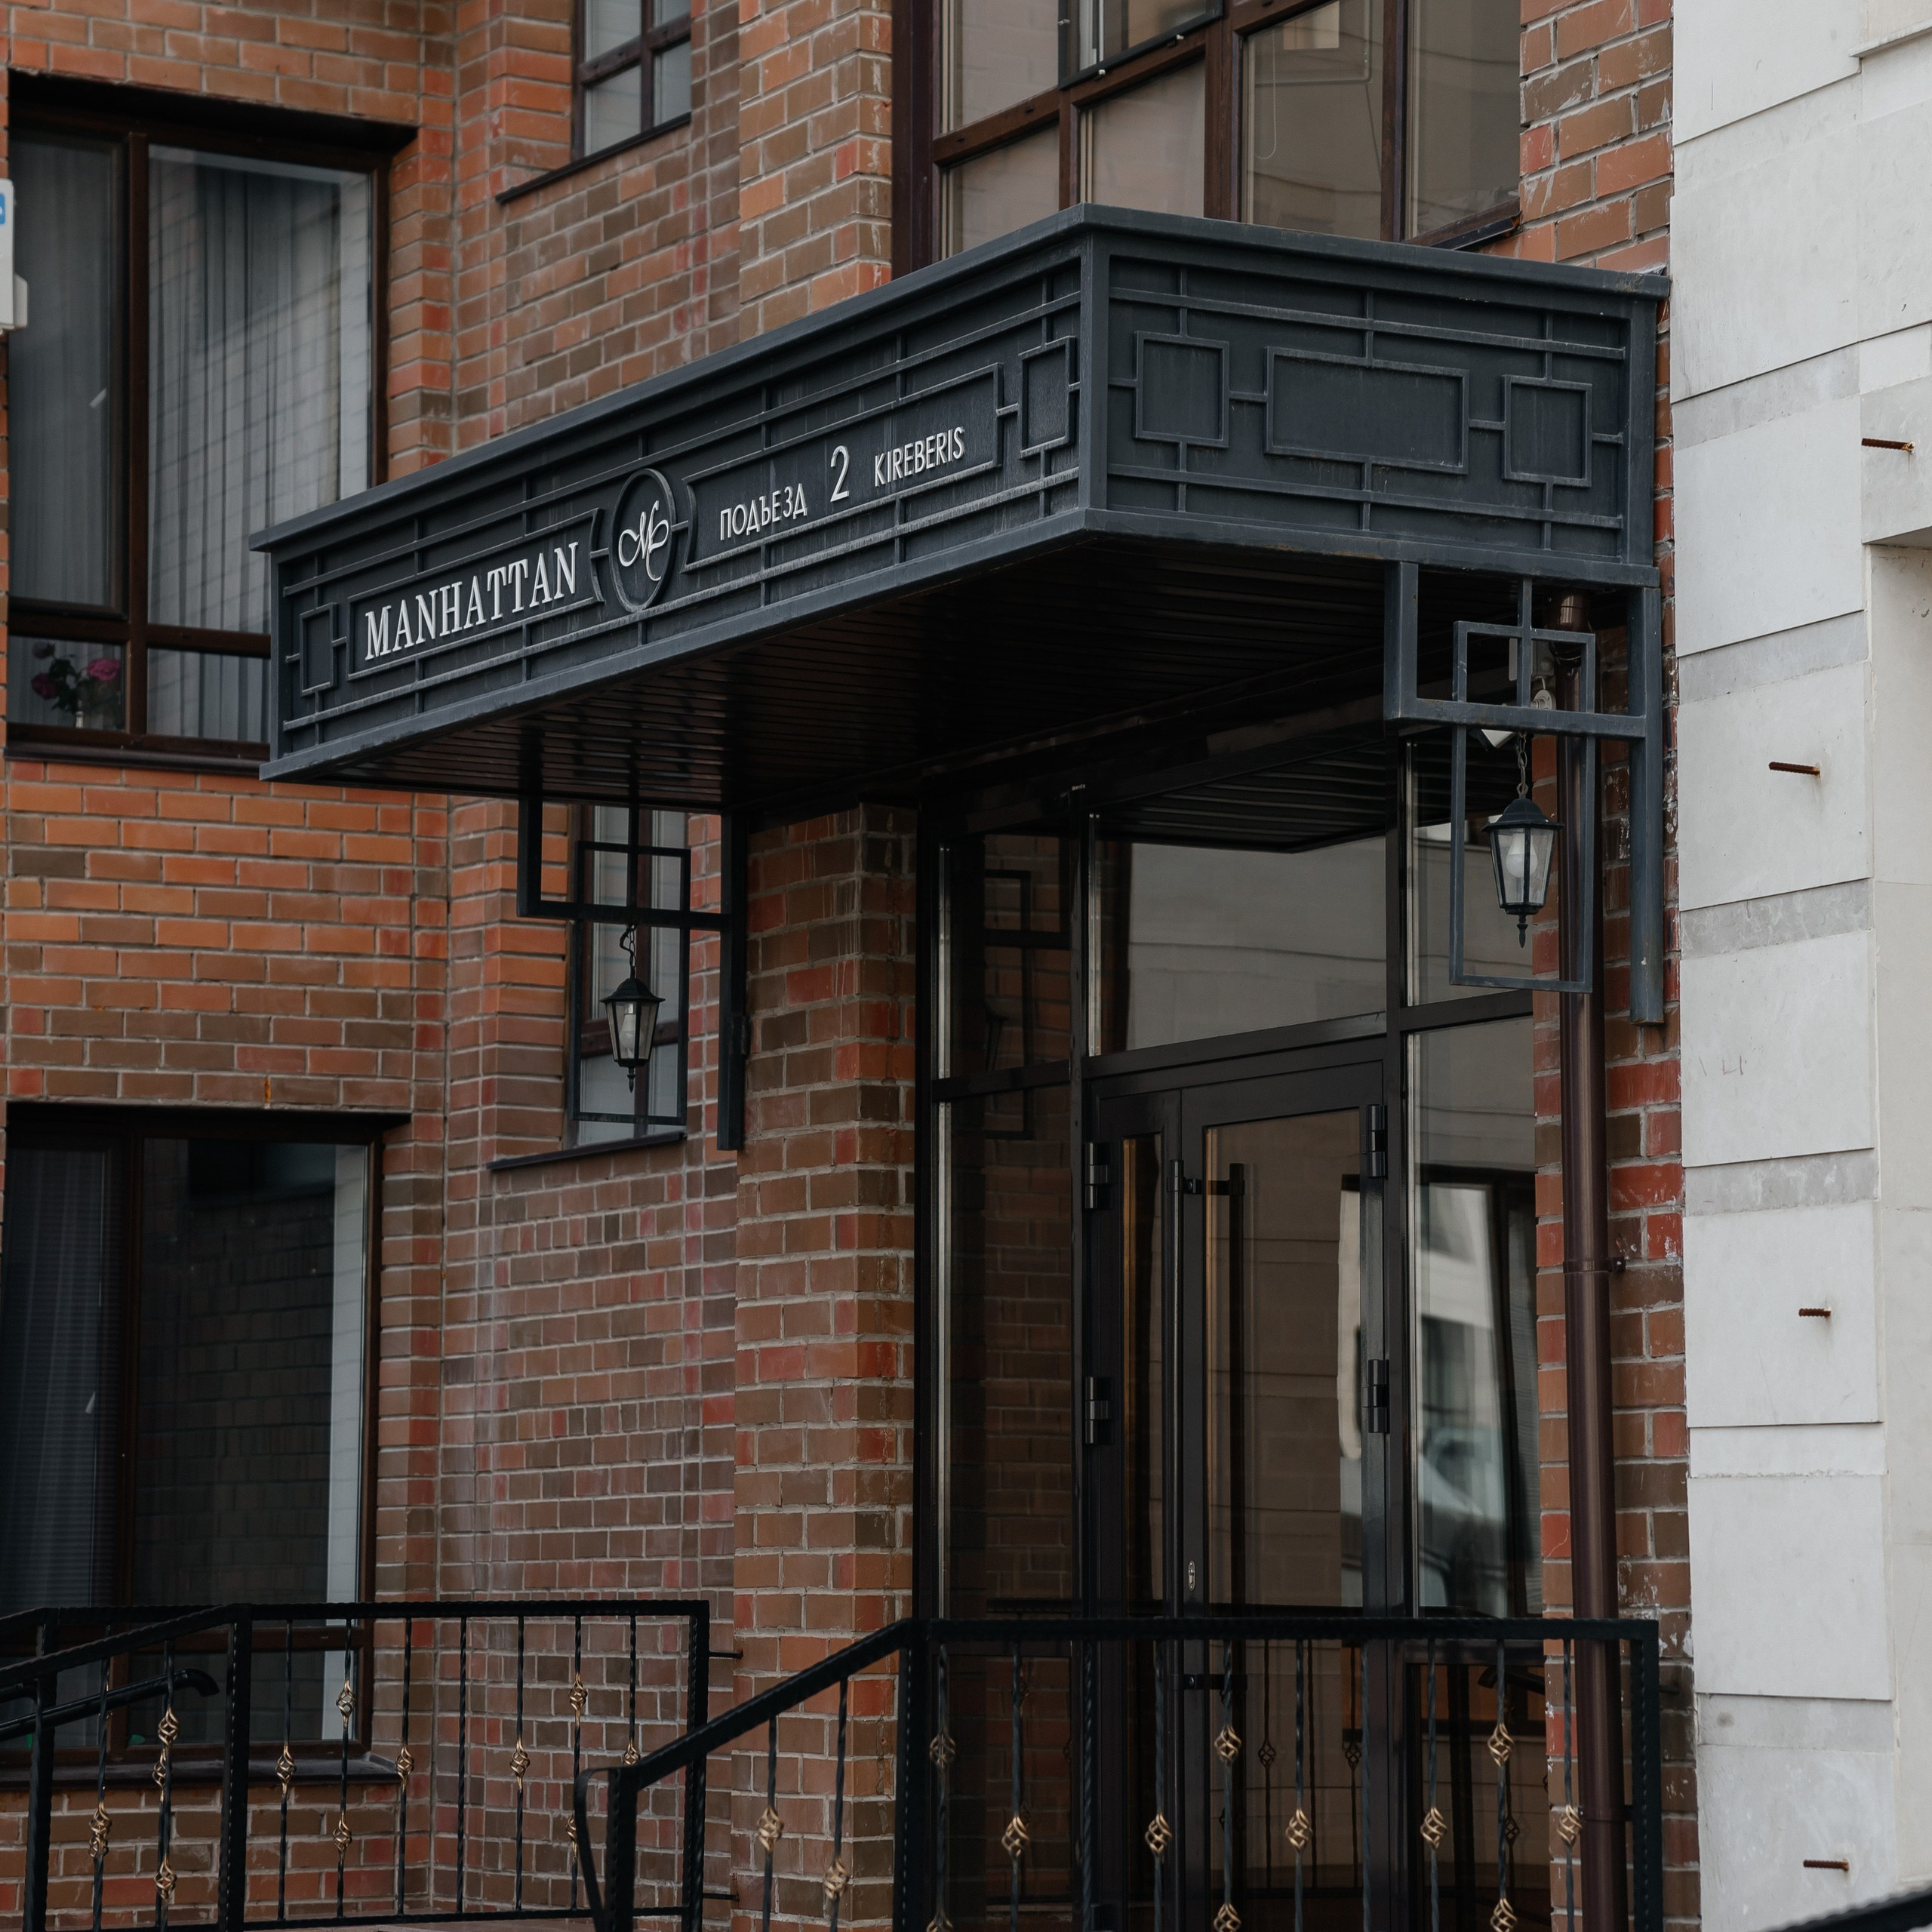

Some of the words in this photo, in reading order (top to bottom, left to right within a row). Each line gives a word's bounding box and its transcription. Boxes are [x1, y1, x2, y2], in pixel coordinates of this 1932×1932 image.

[720, 483, 808, 541] ПОДЪЕЗД
[830, 445, 850, 503] 2
[875, 426, 965, 488] KIREBERIS
[365, 541, 579, 660] MANHATTAN
